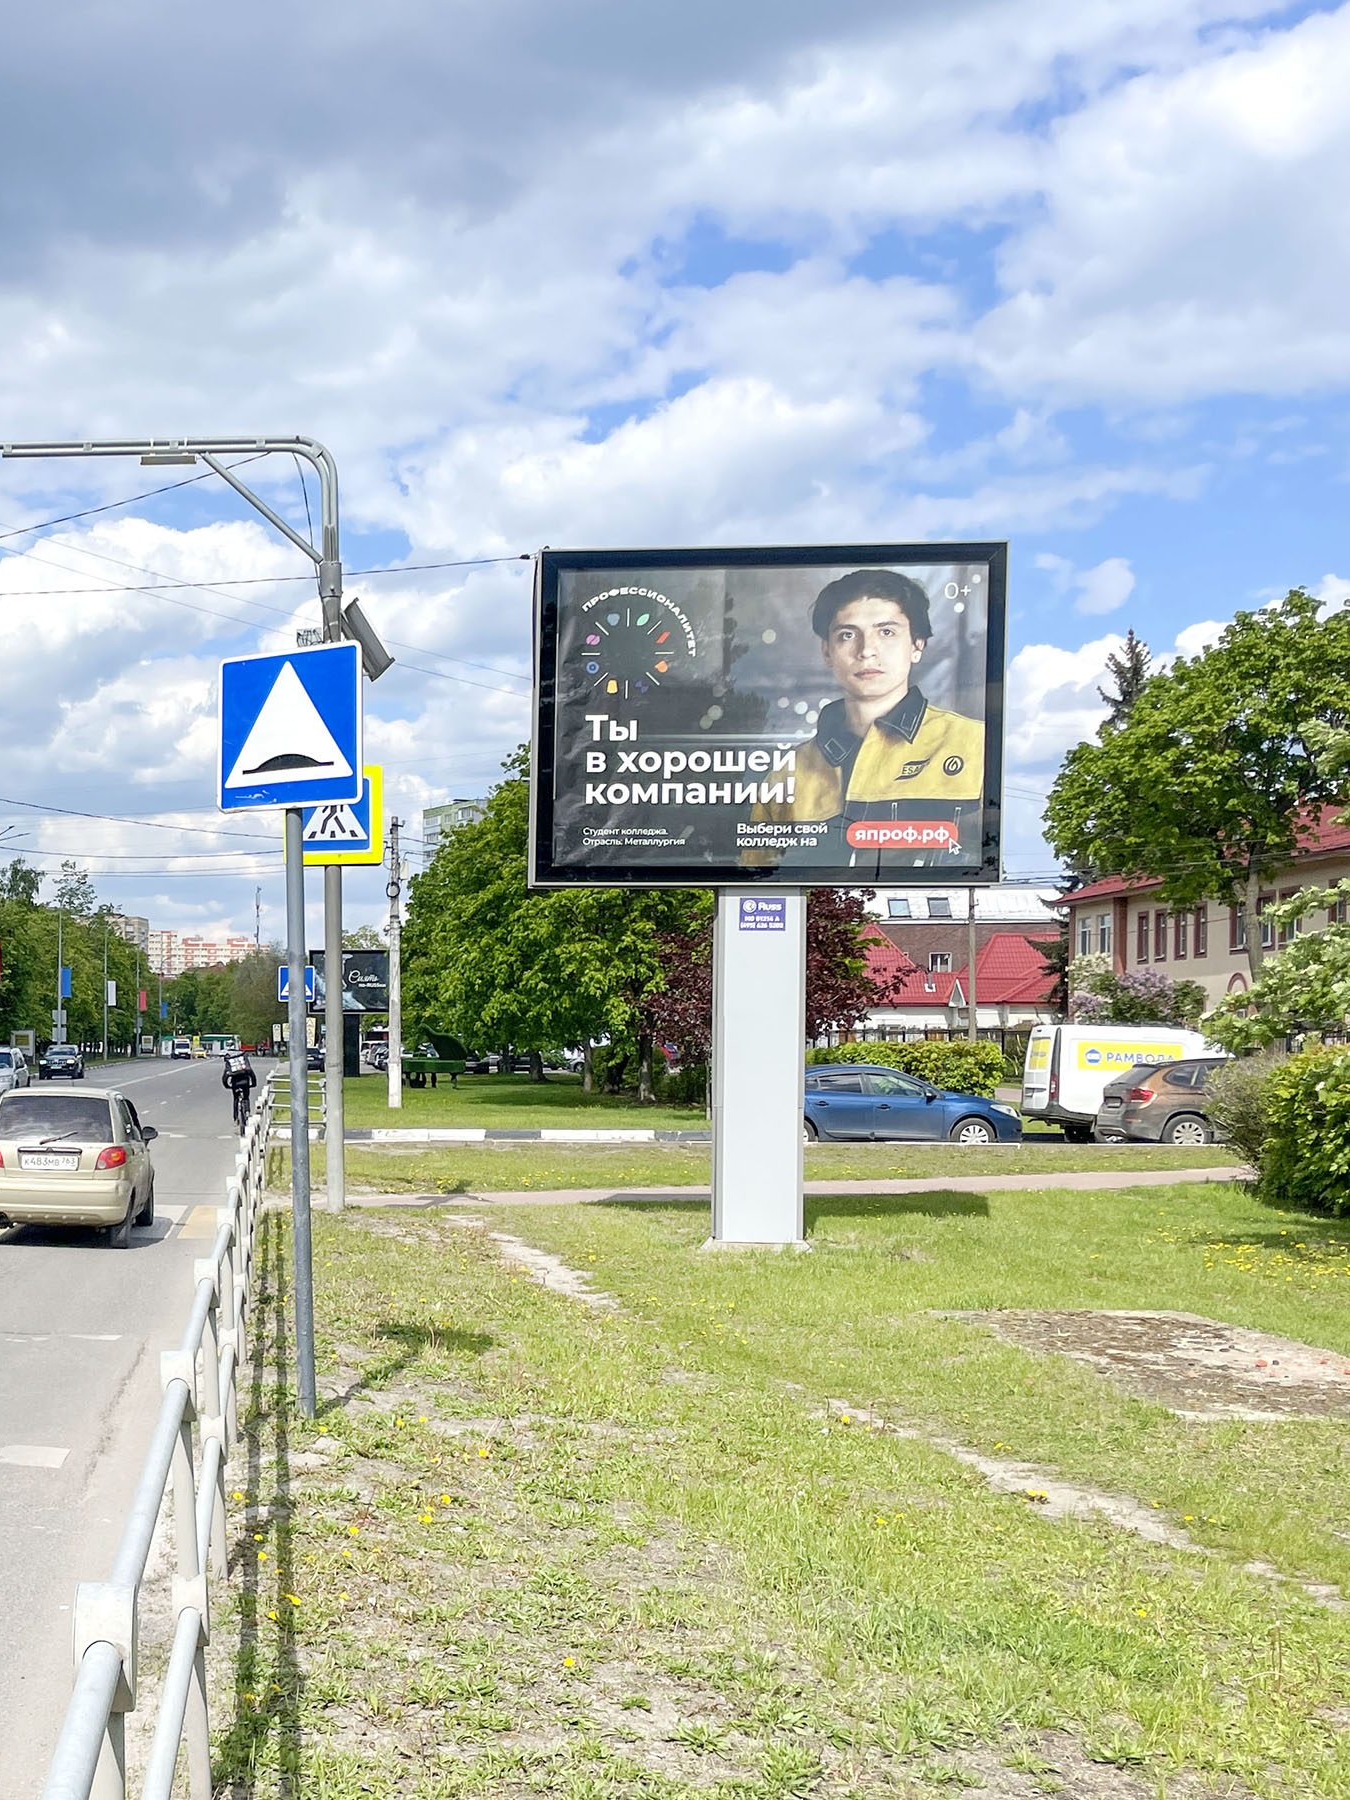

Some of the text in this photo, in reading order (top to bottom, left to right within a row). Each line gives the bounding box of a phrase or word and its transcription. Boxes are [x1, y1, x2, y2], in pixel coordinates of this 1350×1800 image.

[944, 582, 971, 600] 0+
[581, 586, 697, 657] ПРОФЕССИОНАЛИТЕТ
[585, 714, 638, 741] Ты
[586, 742, 796, 779] в хорошей
[585, 776, 795, 805] компании!
[582, 827, 620, 837] Студент
[736, 822, 828, 835] Выбери свой
[855, 825, 950, 844] япроф.рф
[624, 837, 686, 847] Металлургия
[736, 837, 818, 848] колледж на
[758, 902, 782, 911] Russ
